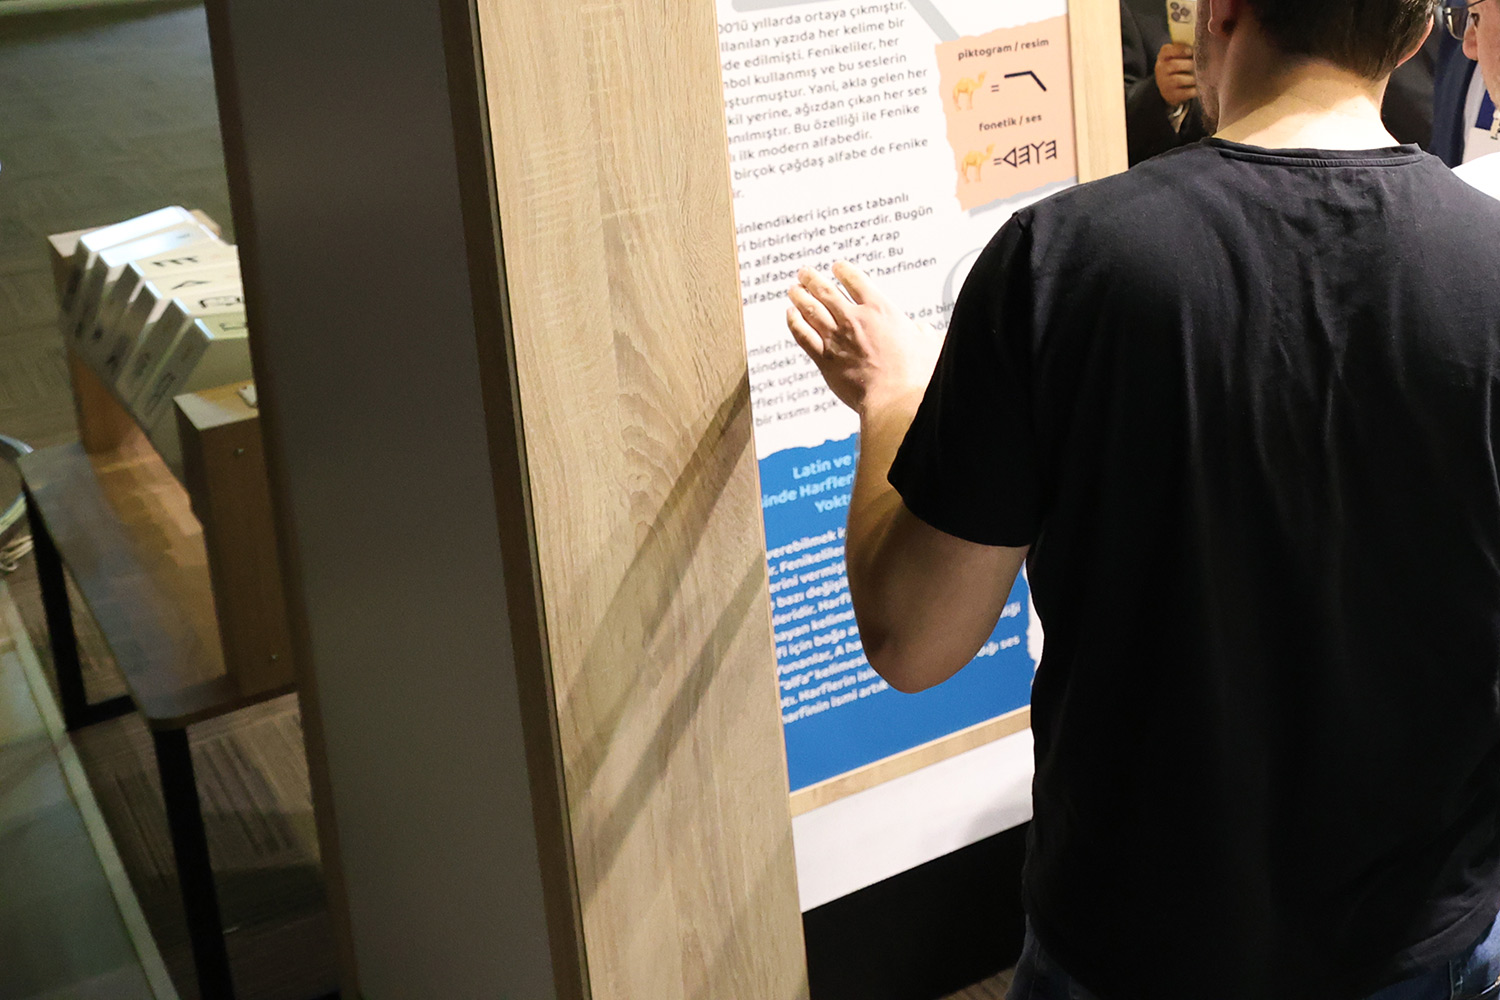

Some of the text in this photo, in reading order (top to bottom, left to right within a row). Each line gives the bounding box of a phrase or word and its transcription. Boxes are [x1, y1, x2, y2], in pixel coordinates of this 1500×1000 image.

[751, 14, 800, 32] yıllarda
[804, 9, 846, 23] ortaya
[849, 2, 906, 19] çıkmıştır.
[818, 28, 839, 39] her
[843, 22, 884, 35] kelime
[887, 19, 904, 29] bir
[878, 38, 898, 48] her
[957, 43, 1013, 61] piktogram
[1020, 38, 1049, 50] resim
[819, 65, 835, 75] ve
[838, 62, 854, 72] bu
[857, 55, 906, 69] seslerin
[841, 77, 867, 90] akla
[870, 72, 904, 88] gelen
[907, 69, 927, 78] her
[794, 99, 844, 117] ağızdan
[847, 94, 880, 109] çıkan
[883, 90, 903, 100] her
[907, 87, 927, 97] ses
[794, 123, 810, 134] Bu
[862, 111, 876, 121] ile
[880, 105, 919, 118] Fenike
[979, 116, 1017, 132] fonetik
[1025, 114, 1042, 124] ses
[758, 141, 808, 157] modern
[812, 131, 871, 148] alfabedir.
[779, 157, 823, 175] çağdaş
[827, 149, 867, 164] alfabe
[870, 145, 884, 156] de
[888, 139, 928, 152] Fenike
[842, 203, 862, 214] ses
[866, 193, 908, 209] tabanlı
[894, 206, 933, 222] Bugün
[871, 230, 899, 243] Arap
[888, 245, 905, 257] Bu
[792, 454, 852, 479] Latin ve
